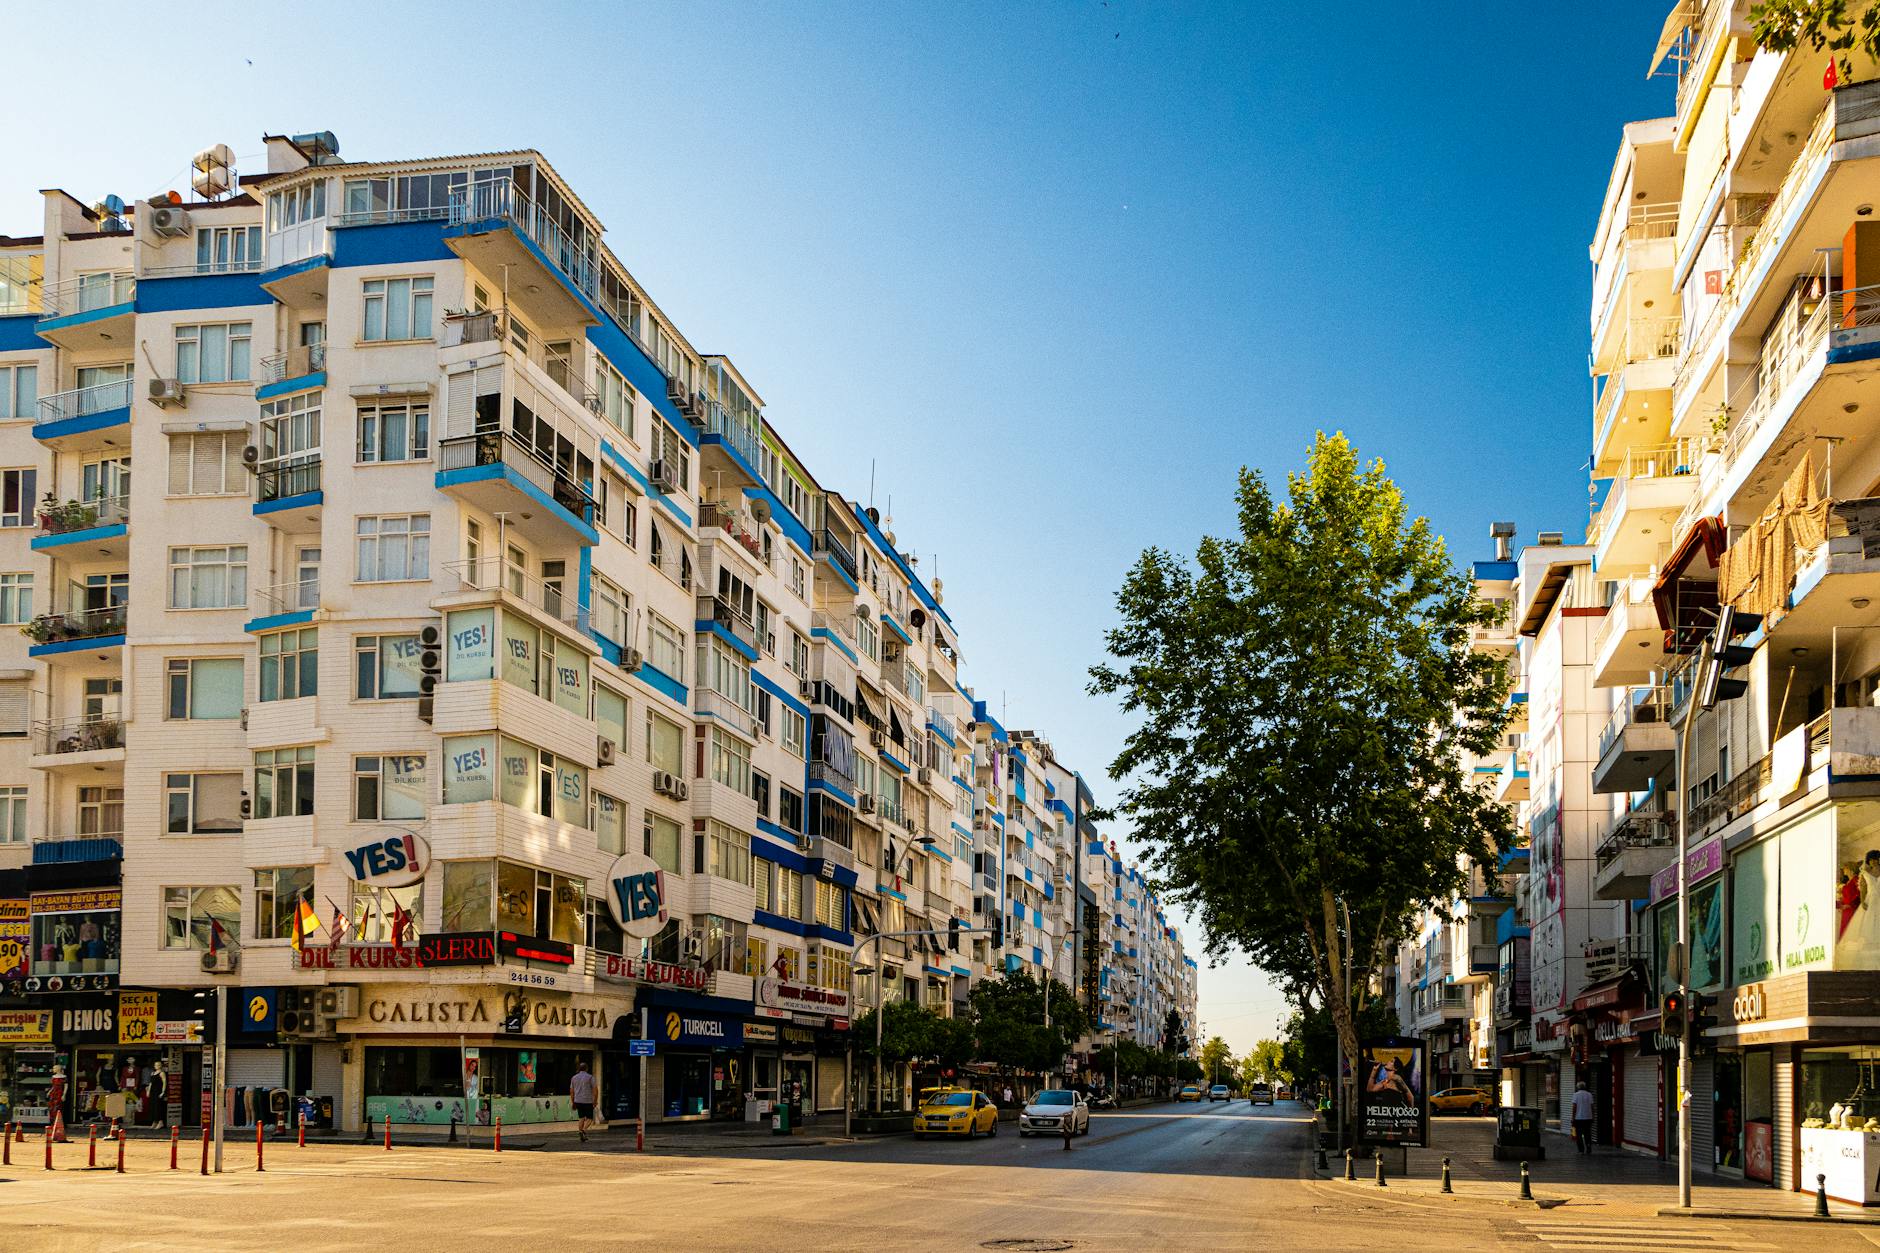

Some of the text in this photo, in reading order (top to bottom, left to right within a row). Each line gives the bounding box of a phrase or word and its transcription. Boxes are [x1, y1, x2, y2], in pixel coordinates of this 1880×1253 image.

[453, 624, 487, 651] YES!
[507, 638, 530, 660] YES!
[557, 667, 580, 688] YES!
[453, 747, 487, 774] YES!
[504, 757, 529, 777] YES!
[344, 834, 420, 880] YES!
[613, 870, 668, 923] YES!
[1804, 945, 1826, 965] MODA
[511, 972, 556, 986] 244 56 59
[645, 963, 706, 989] KURSU
[142, 995, 155, 1004] AL
[62, 1008, 113, 1032] DEMOS
[122, 1006, 155, 1017] KOTLAR
[369, 999, 489, 1023] CALISTA
[534, 1000, 608, 1030] CALISTA
[683, 1018, 725, 1037] TURKCELL
[1366, 1118, 1376, 1127] 22
